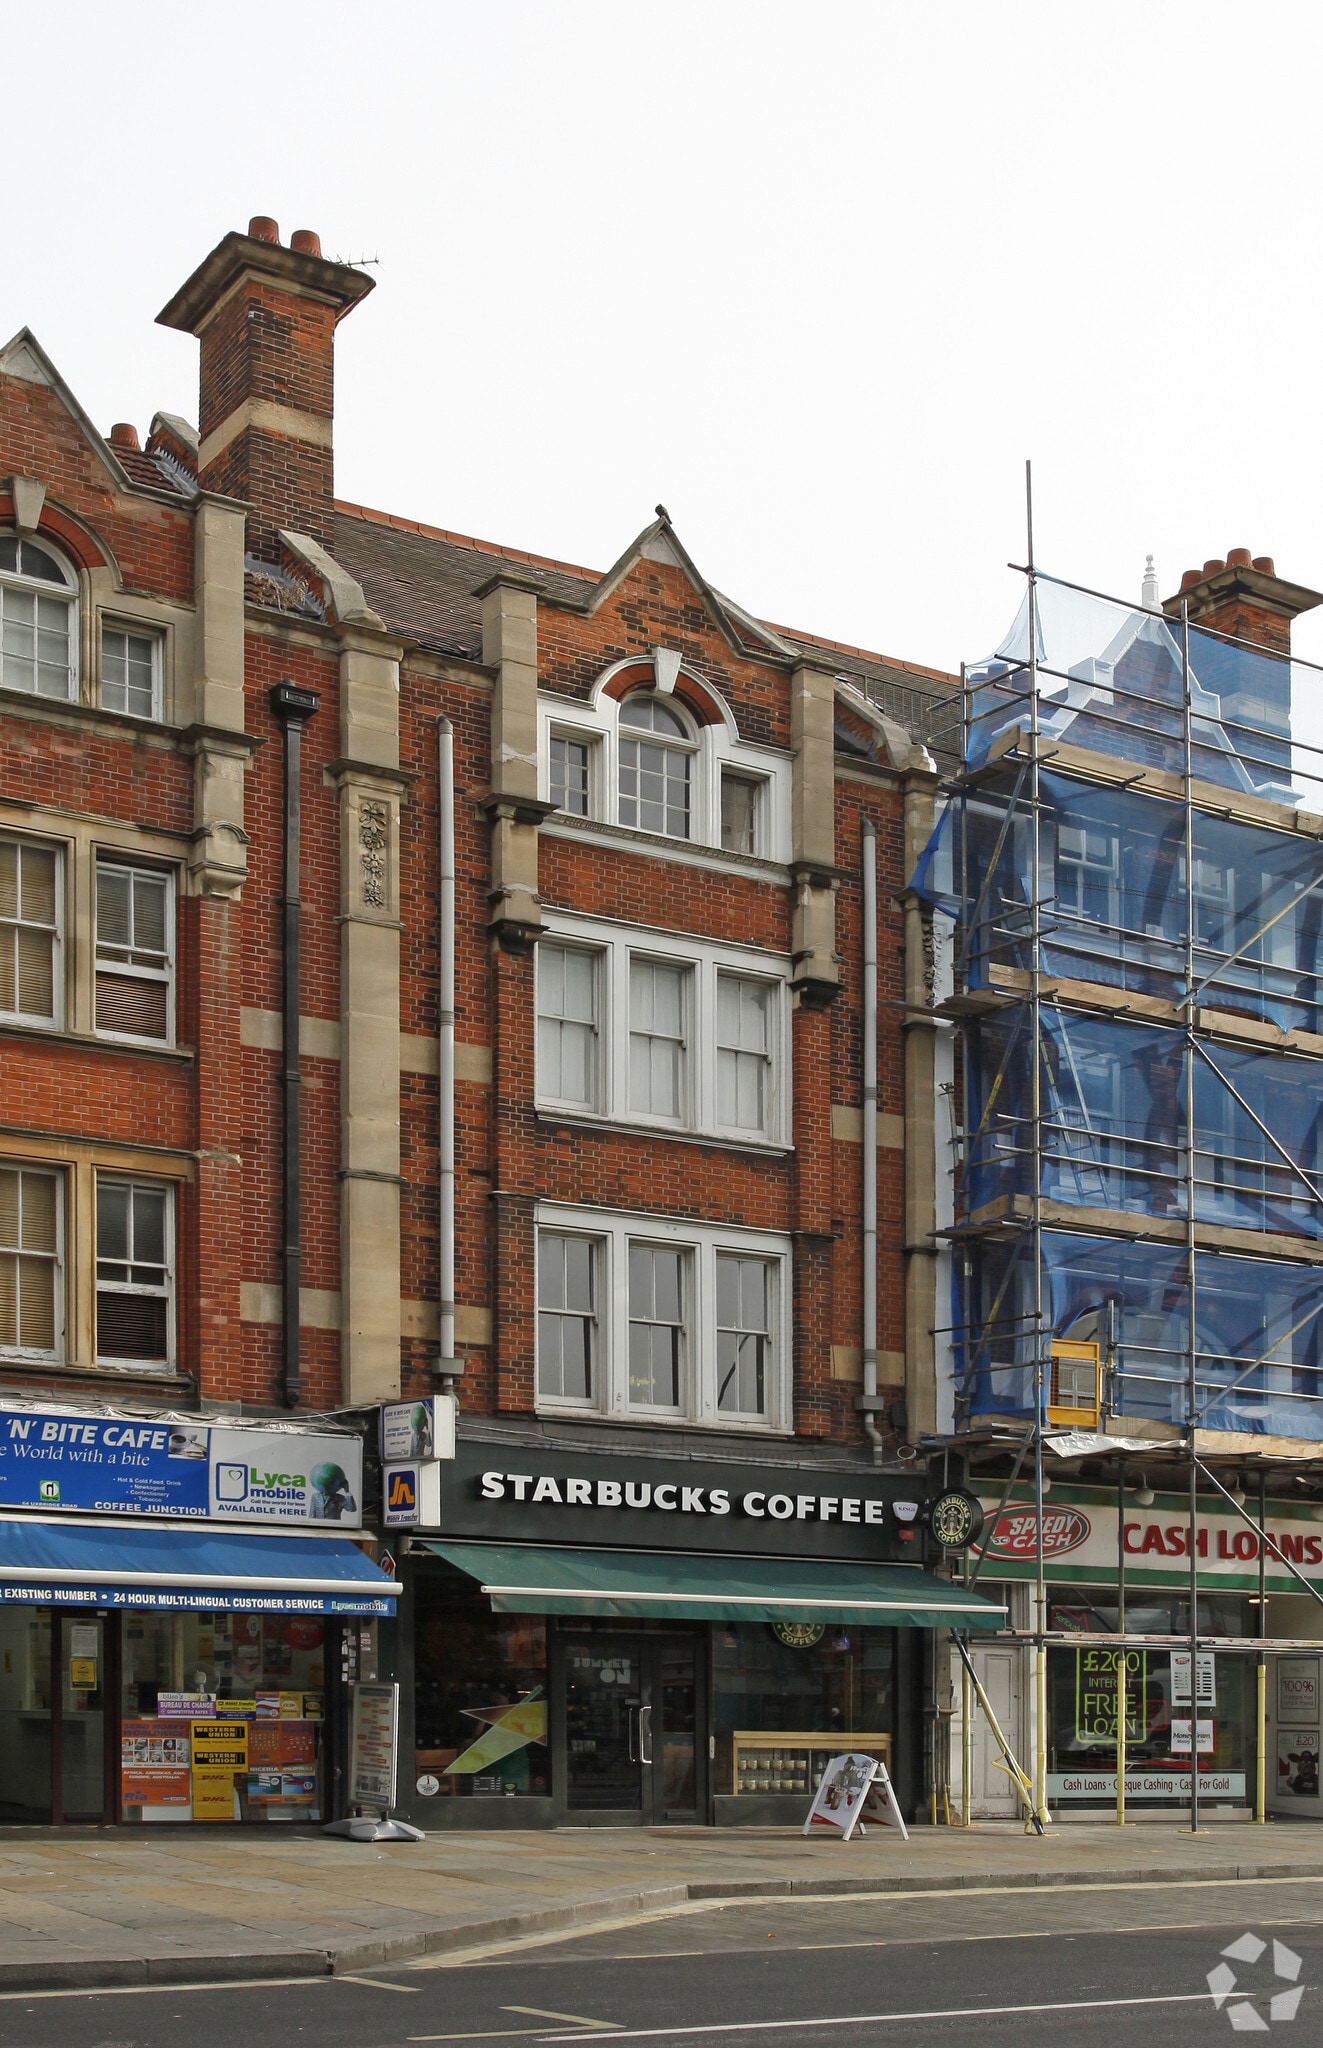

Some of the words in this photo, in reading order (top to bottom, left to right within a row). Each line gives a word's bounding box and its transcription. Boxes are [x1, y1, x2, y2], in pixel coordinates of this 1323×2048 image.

[41, 1421, 98, 1445] BITE
[103, 1426, 167, 1450] CAFE
[13, 1444, 64, 1460] World
[69, 1448, 103, 1463] with
[108, 1453, 116, 1464] a
[121, 1451, 150, 1466] bite
[250, 1468, 306, 1489] Lyca
[130, 1490, 169, 1498] Confectionery
[250, 1488, 306, 1500] mobile
[481, 1471, 730, 1515] STARBUCKS
[743, 1491, 884, 1524] COFFEE
[94, 1501, 142, 1511] COFFEE
[145, 1504, 206, 1515] JUNCTION
[218, 1504, 276, 1514] AVAILABLE
[279, 1508, 307, 1516] HERE
[936, 1497, 970, 1518] STARBUCKS
[937, 1530, 964, 1543] COFFEE
[1121, 1523, 1207, 1557] CASH
[1218, 1529, 1322, 1564] LOANS
[5, 1588, 52, 1600] EXISTING
[54, 1590, 97, 1601] NUMBER
[113, 1592, 126, 1603] 24
[128, 1593, 156, 1604] HOUR
[158, 1594, 231, 1608] MULTI-LINGUAL
[233, 1597, 284, 1609] CUSTOMER
[286, 1599, 324, 1609] SERVICE
[332, 1600, 388, 1611] Lycamobile
[781, 1632, 816, 1645] COFFEE
[1283, 1680, 1314, 1692] 100%
[1063, 1778, 1082, 1790] Cash
[1084, 1778, 1106, 1790] Loans
[1113, 1778, 1141, 1793] Ceque
[1143, 1778, 1173, 1792] Cashing
[1199, 1778, 1211, 1790] For
[1212, 1778, 1230, 1790] Gold
